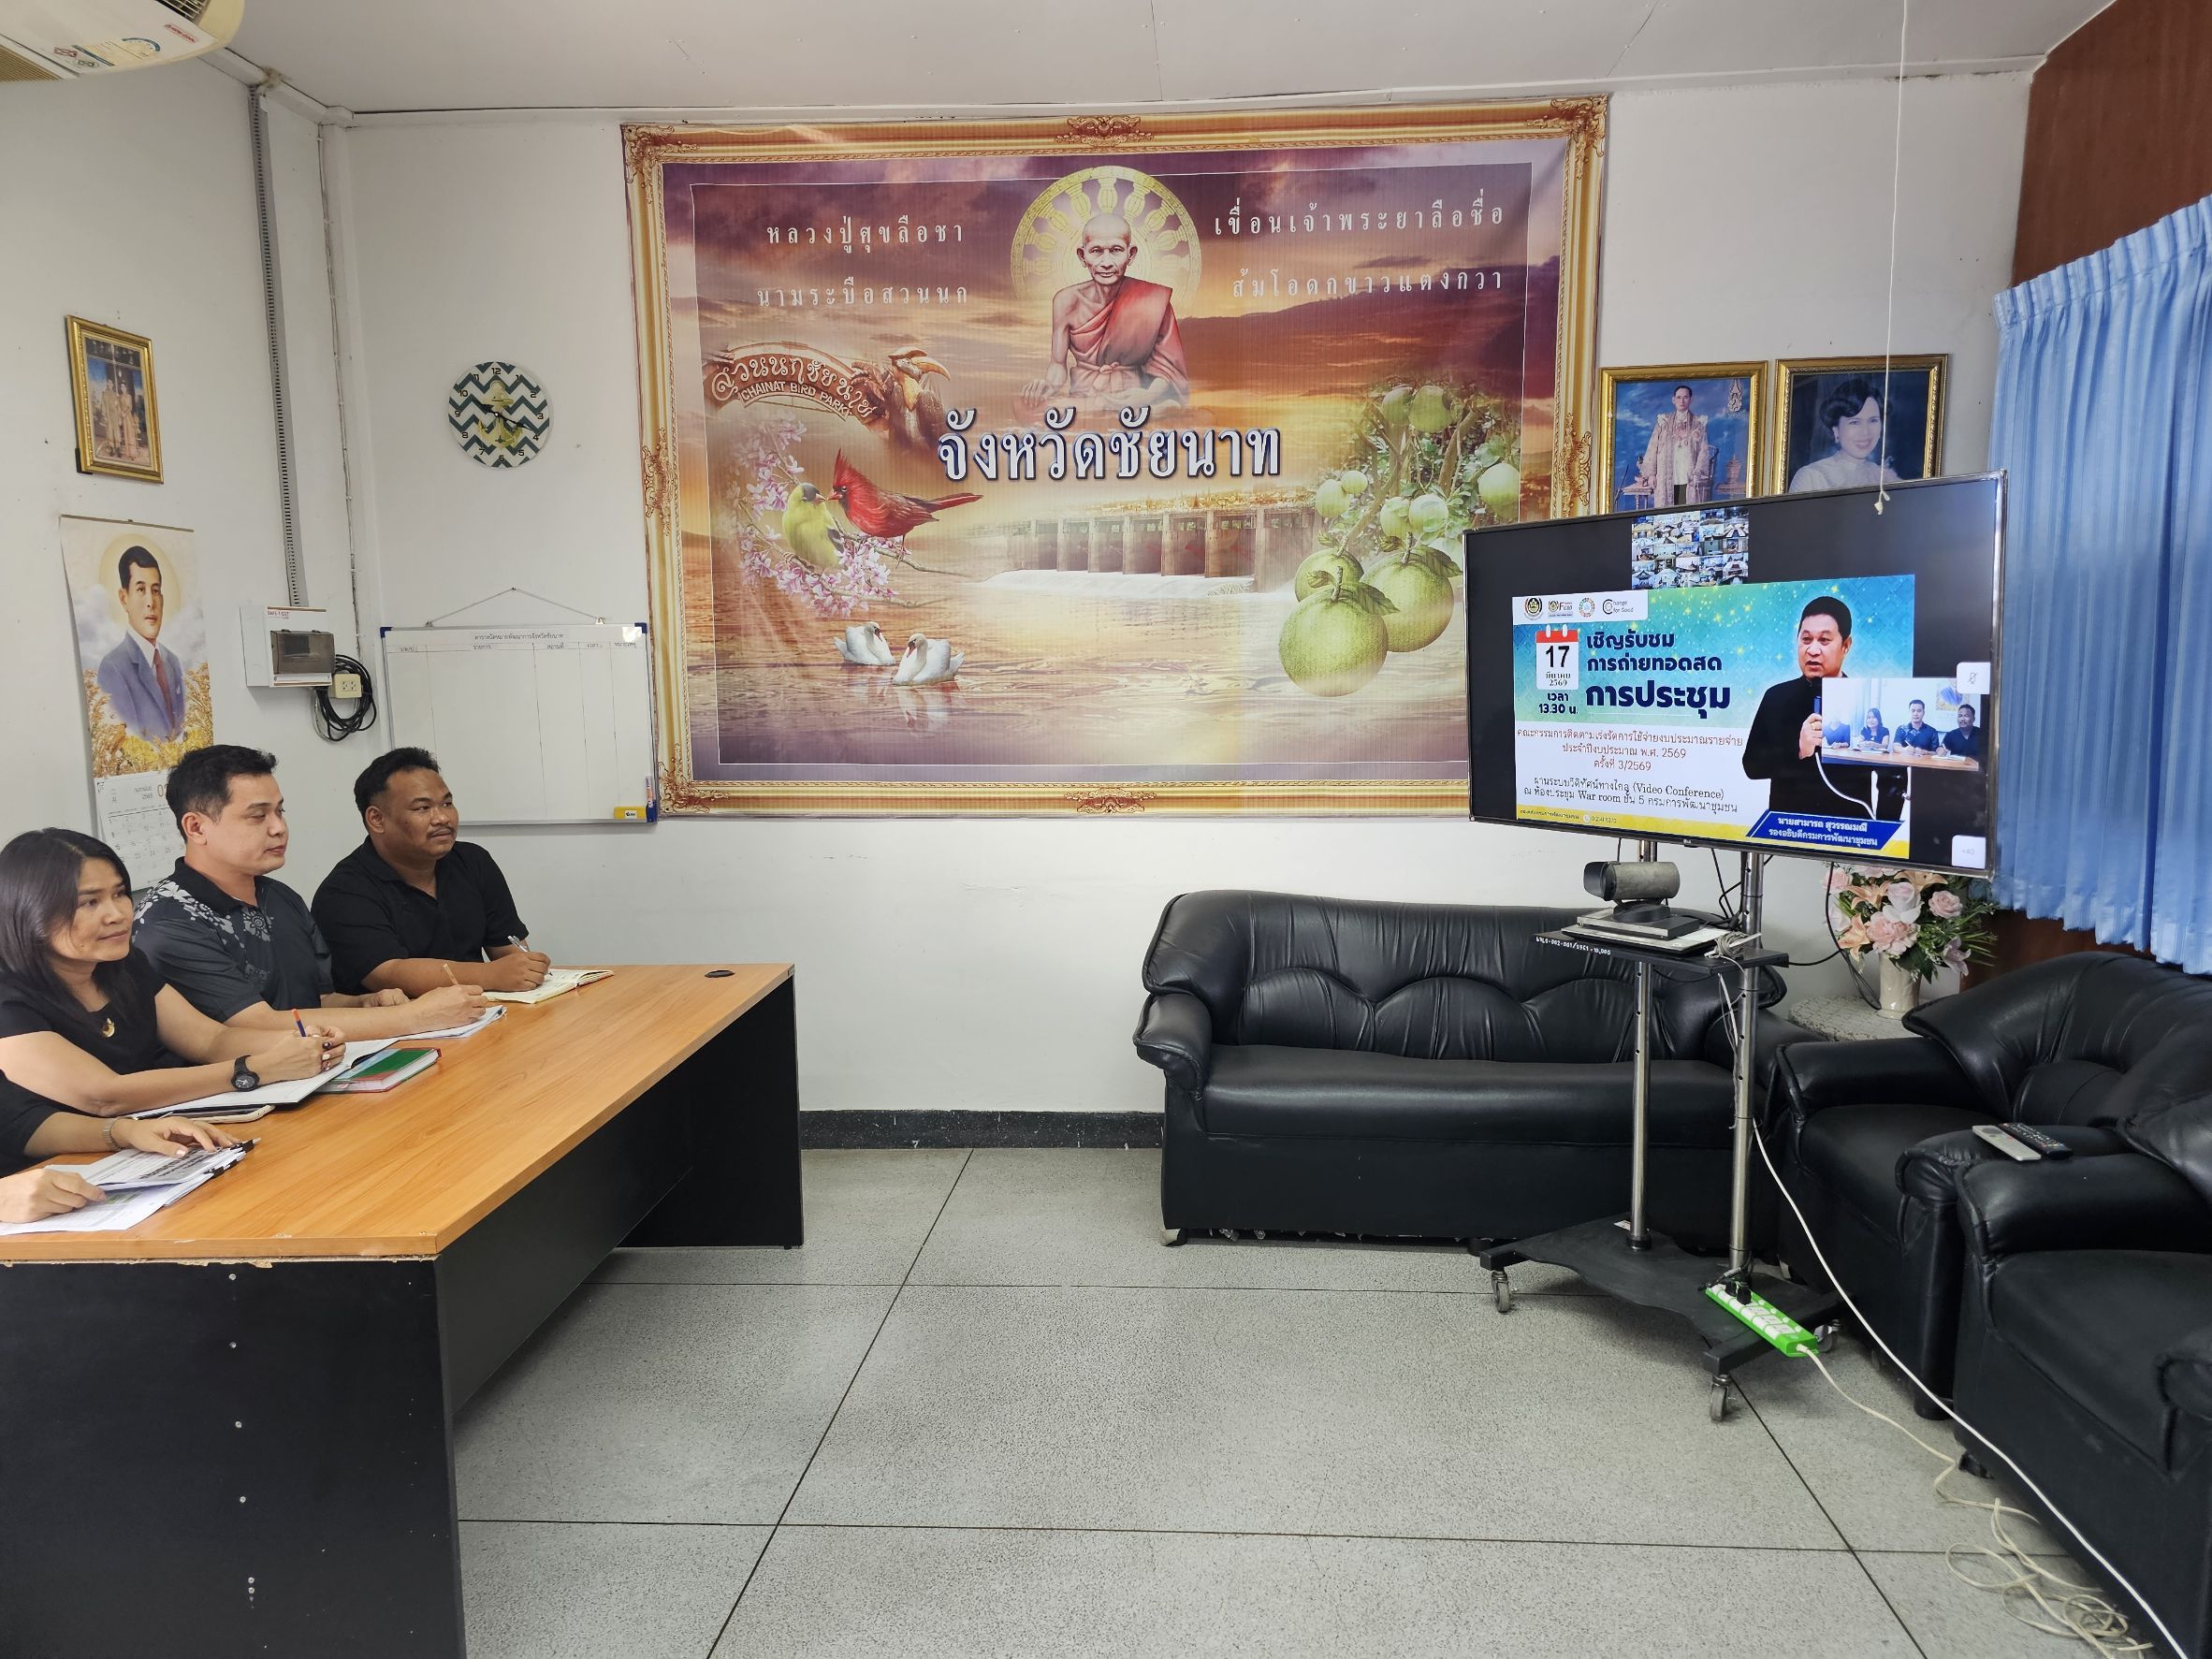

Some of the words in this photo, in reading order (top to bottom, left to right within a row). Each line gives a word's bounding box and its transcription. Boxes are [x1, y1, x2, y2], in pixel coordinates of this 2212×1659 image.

[1215, 188, 1504, 237] เขื่อนเจ้าพระยาลือชื่อ
[766, 214, 964, 254] หลวงปู่ศุขลือชา
[757, 276, 968, 307] นามระบือสวนนก
[1232, 268, 1503, 298] ส้มโอดกขาวแตงกวา
[740, 381, 786, 402] CHAINAT
[790, 384, 816, 397] BIRD
[820, 391, 850, 416] PARK
[938, 405, 1282, 482] จังหวัดชัยนาท
[1587, 629, 1675, 649] เชิญรับชม
[1546, 645, 1570, 668] 17
[1587, 652, 1723, 672] การถ่ายทอดสด
[1549, 678, 1567, 687] 2569
[1548, 691, 1569, 702] เวลา
[1585, 679, 1731, 719] การประชุม
[1538, 703, 1566, 714] 13.30
[1569, 705, 1579, 715] น.
[1594, 755, 1615, 769] ครั้งที่
[1618, 760, 1652, 771] 3/2569
[1640, 748, 1659, 758] พ.ศ.
[1662, 748, 1686, 758] 2569
[1523, 787, 1532, 795] ณ
[1578, 790, 1596, 801] War
[1598, 793, 1622, 803] room
[1638, 795, 1645, 805] 5
[1648, 797, 1738, 814] กรมการพัฒนาชุมชน
[1633, 781, 1663, 794] (Video
[1666, 785, 1724, 800] Conference)
